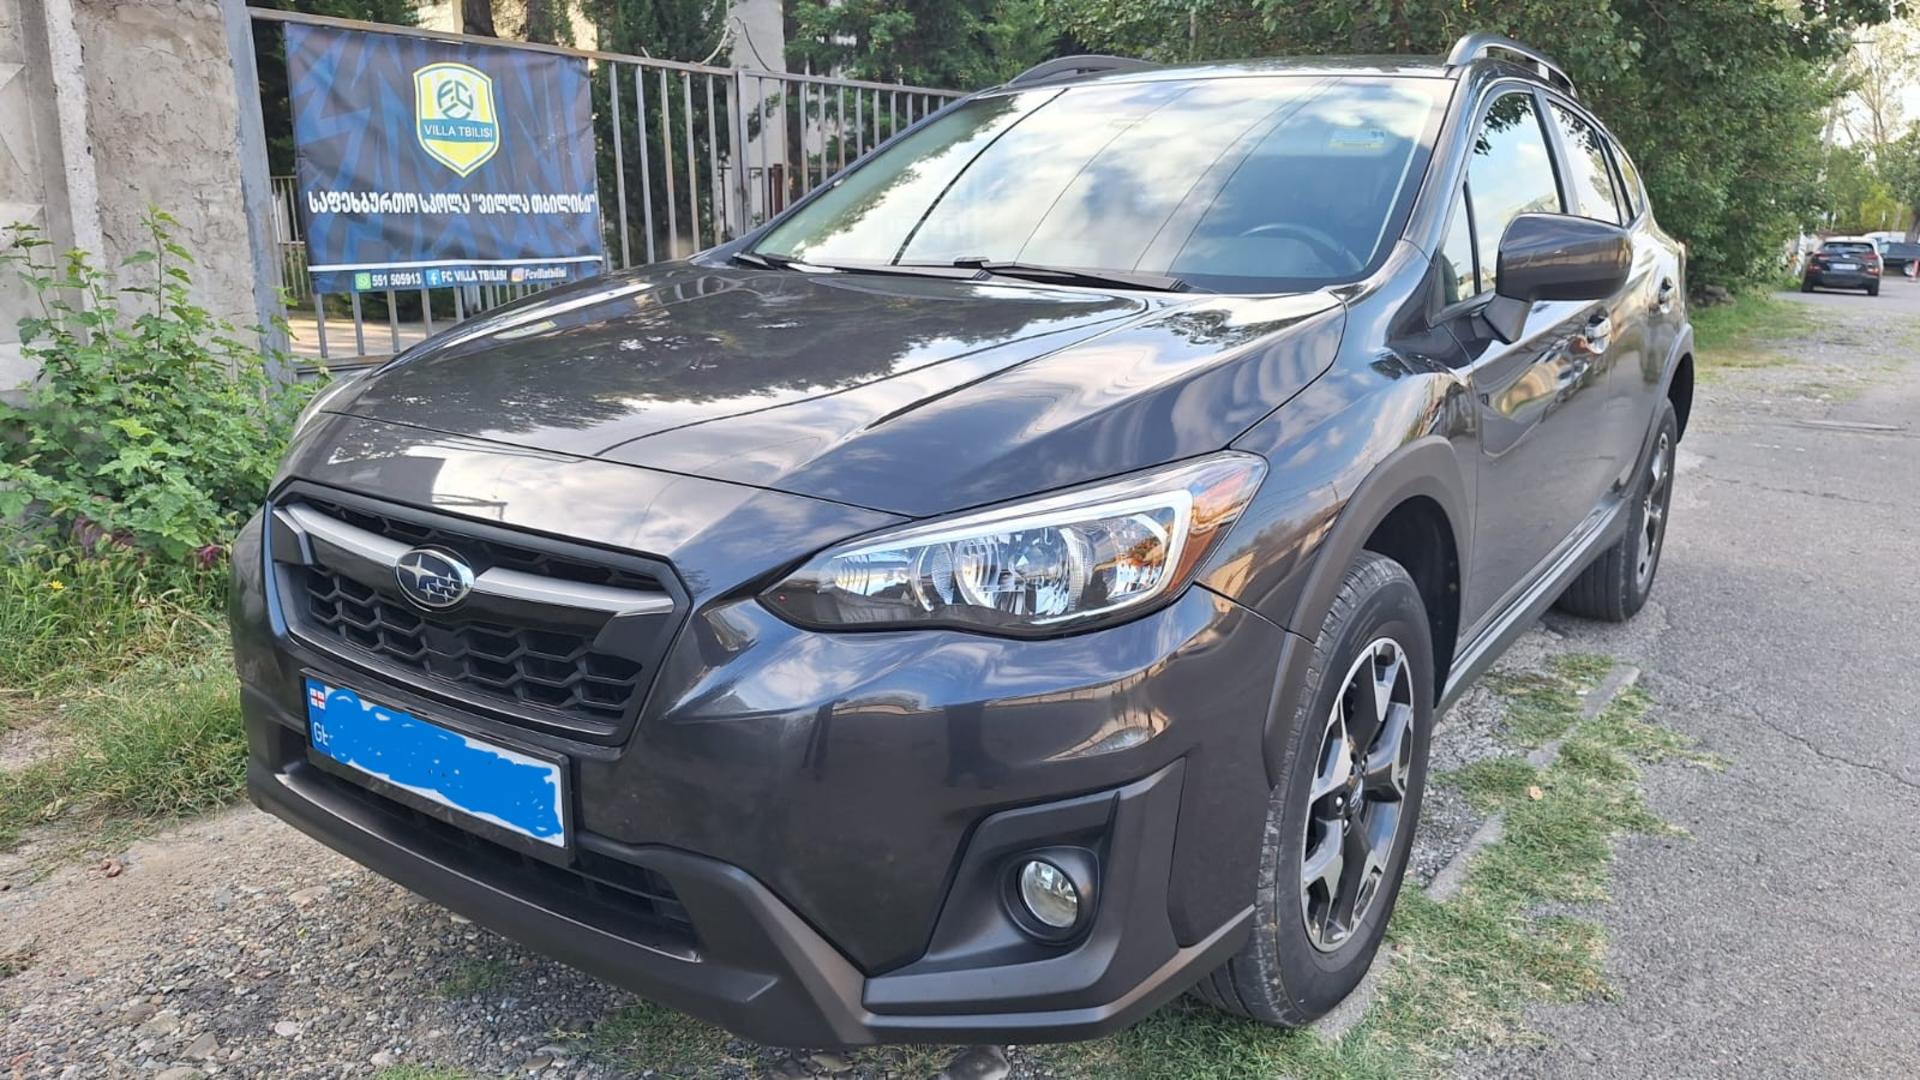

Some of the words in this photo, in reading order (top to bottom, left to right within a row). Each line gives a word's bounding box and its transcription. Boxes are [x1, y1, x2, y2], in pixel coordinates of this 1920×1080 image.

[424, 124, 456, 136] VILLA
[458, 125, 493, 138] TBILISI
[418, 192, 470, 214] სკოლა
[372, 274, 388, 288] 551
[390, 272, 421, 286] 505913
[441, 270, 453, 283] FC
[454, 269, 478, 282] VILLA
[478, 269, 507, 281] TBILISI
